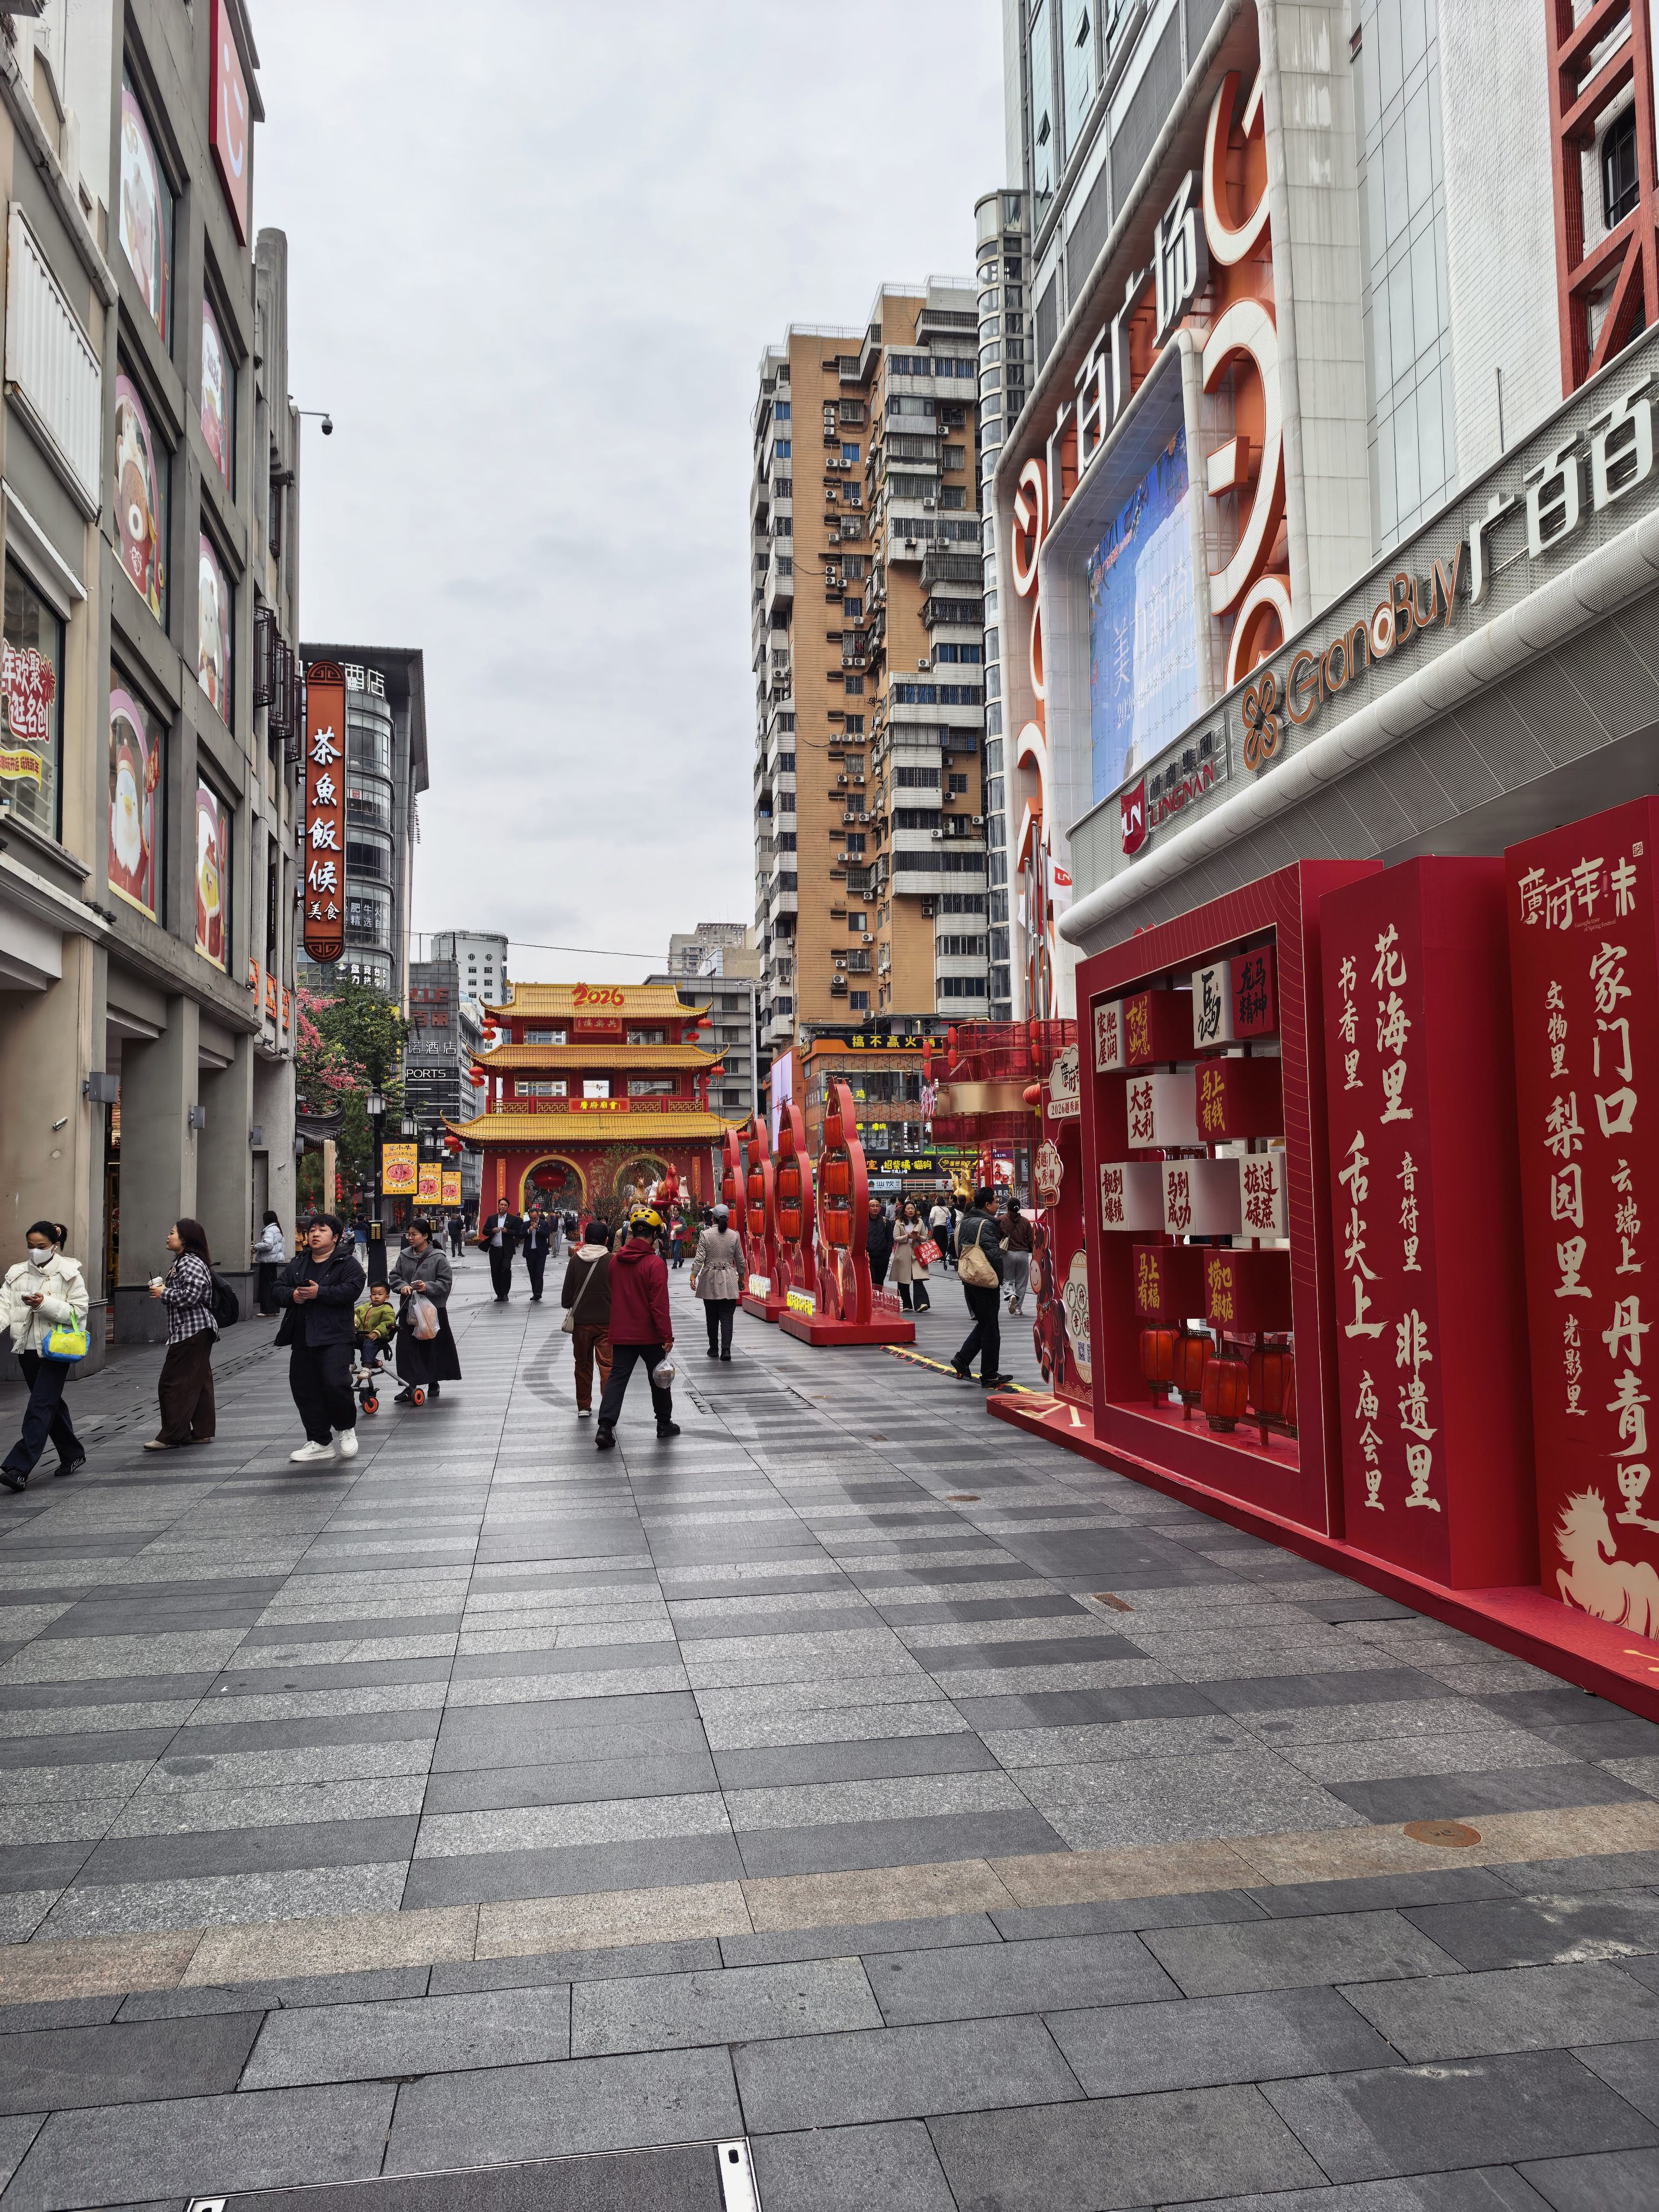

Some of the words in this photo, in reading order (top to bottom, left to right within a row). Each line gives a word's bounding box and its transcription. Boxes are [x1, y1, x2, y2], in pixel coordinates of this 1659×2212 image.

[1046, 169, 1201, 530] 广百广场
[1286, 542, 1461, 725] GrandBuy
[1469, 374, 1653, 606] 广百百
[308, 726, 342, 894] 茶魚飯候
[1150, 760, 1213, 826] LINGNAN
[307, 901, 340, 920] 美食
[572, 982, 624, 1007] 2026
[1338, 956, 1364, 1090] 书香里
[1371, 924, 1413, 1124] 花海里
[1546, 981, 1569, 1079] 文物里
[405, 1069, 446, 1078] PORTS
[408, 1041, 457, 1054] 诺酒店
[852, 1035, 935, 1048] 搞不赢火锅
[1061, 1061, 1080, 1093] 廣府
[1590, 942, 1637, 1138] 家门口
[1130, 1081, 1152, 1113] 大吉
[1131, 1111, 1154, 1142] 大利
[1201, 1070, 1225, 1101] 马上
[1202, 1097, 1225, 1132] 有钱
[1168, 1171, 1189, 1203] 马到
[1168, 1198, 1191, 1230] 成功
[1396, 1152, 1421, 1272] 音符里
[1544, 1091, 1593, 1298] 梨园里
[1611, 1159, 1645, 1274] 云端上
[1138, 1252, 1159, 1282] 马上
[1338, 1130, 1388, 1339] 舌尖上
[1138, 1280, 1160, 1311] 有福
[1563, 1314, 1587, 1416] 光影里
[1355, 1370, 1385, 1511] 庙会里
[1395, 1308, 1441, 1512] 非遗里
[1599, 1295, 1659, 1534] 丹青里
